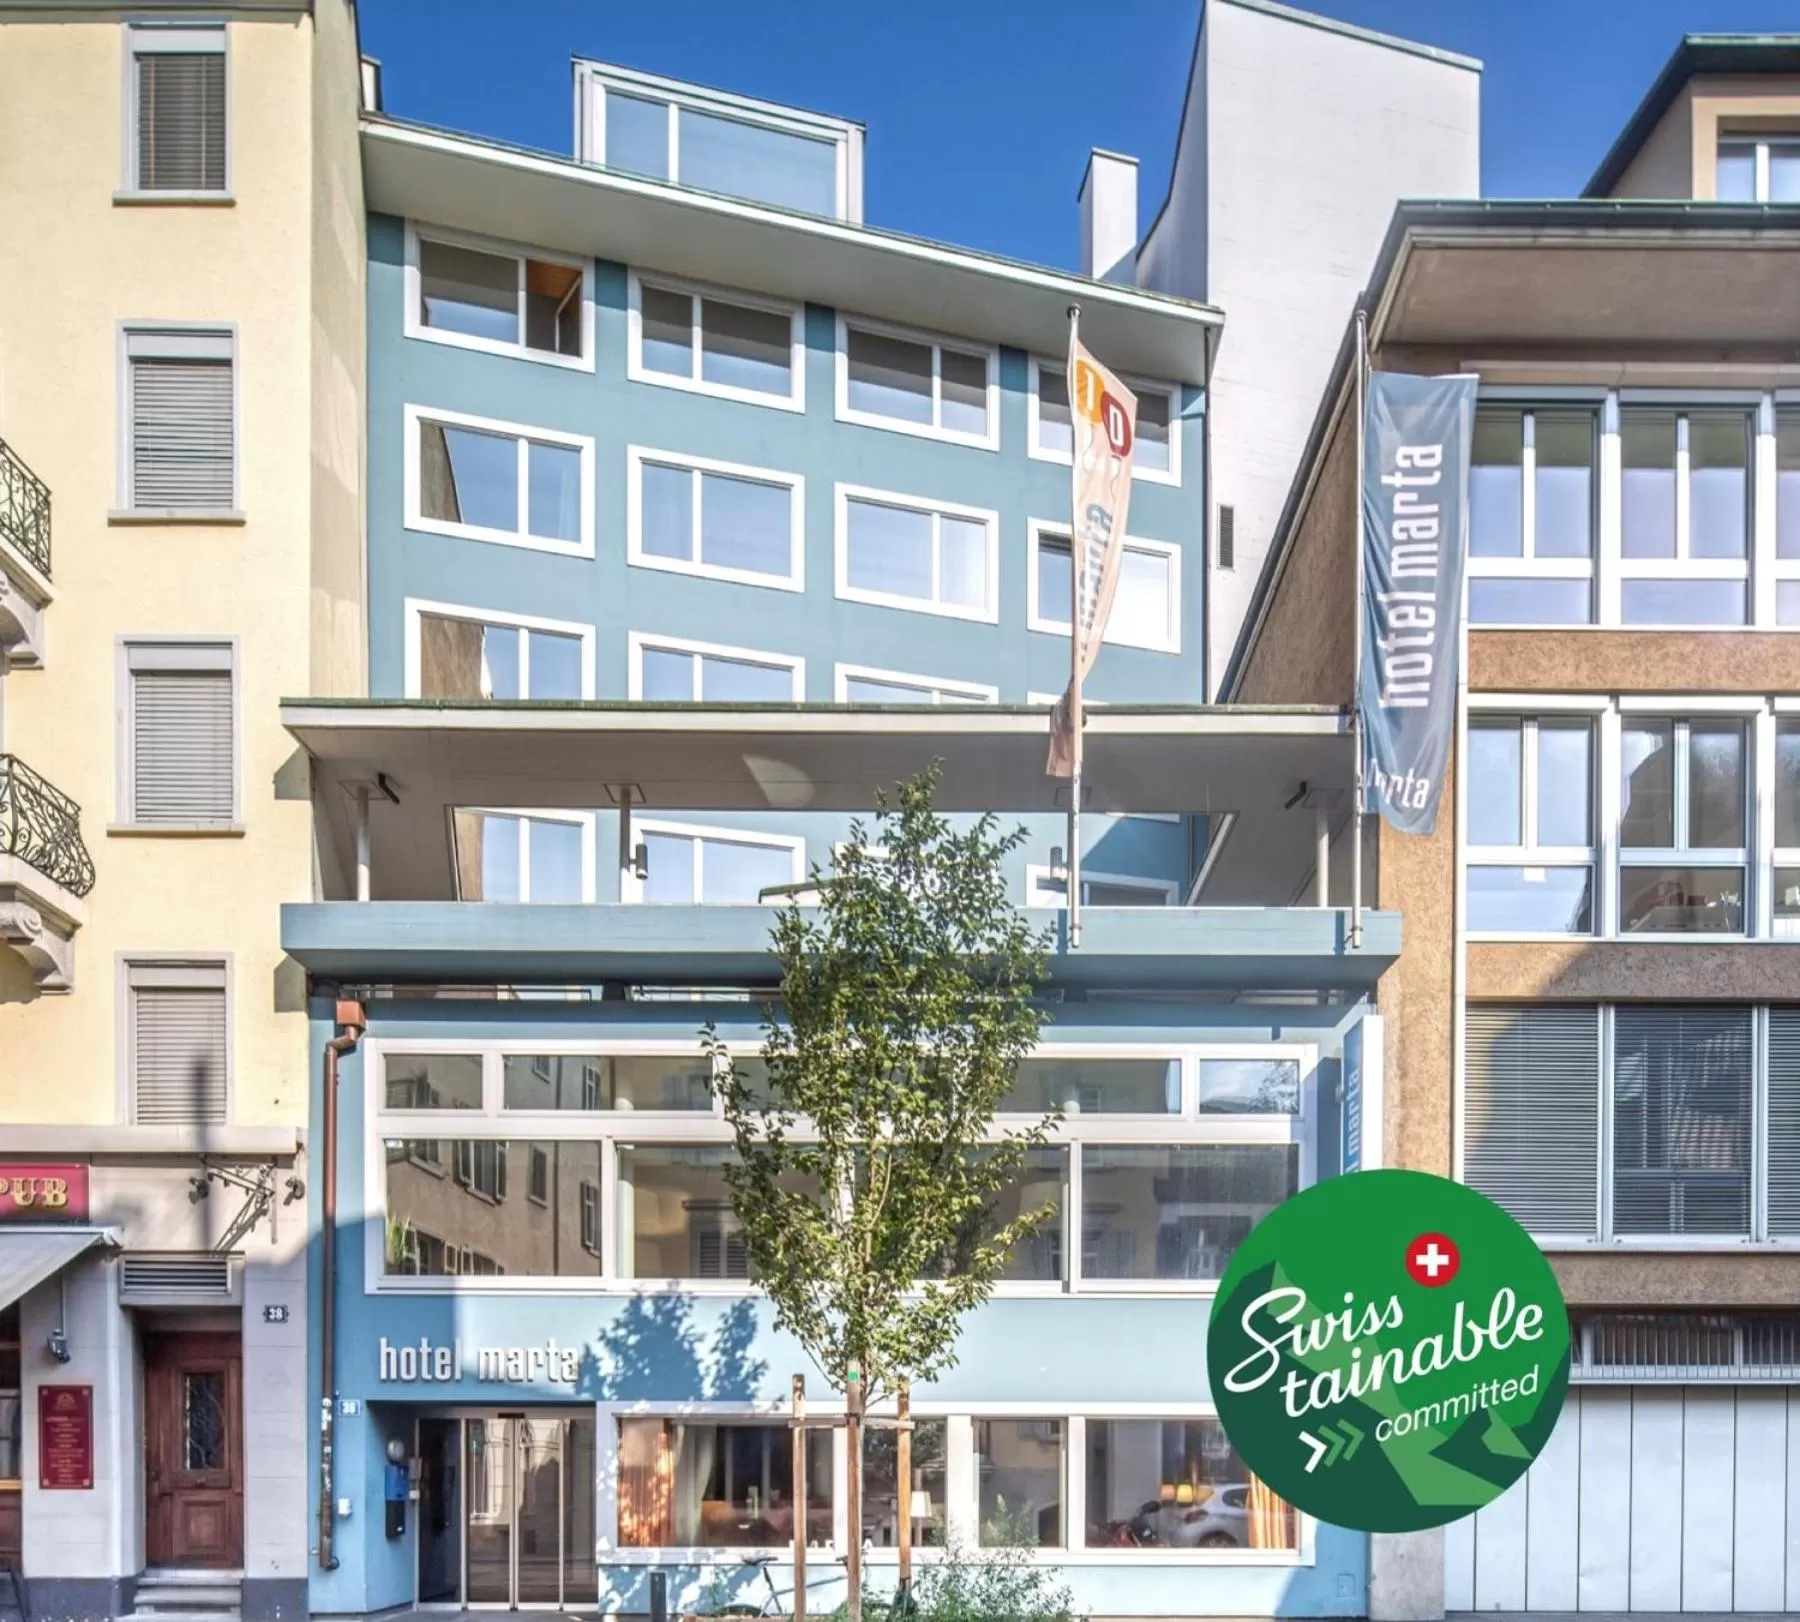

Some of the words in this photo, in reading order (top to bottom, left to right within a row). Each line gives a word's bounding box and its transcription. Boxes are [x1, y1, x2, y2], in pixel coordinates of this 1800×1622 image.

[1381, 443, 1443, 577] marta
[1377, 591, 1437, 709] hotel
[1346, 1066, 1360, 1157] marta
[269, 1307, 283, 1320] 38
[379, 1337, 462, 1382] hotel
[479, 1337, 579, 1383] marta
